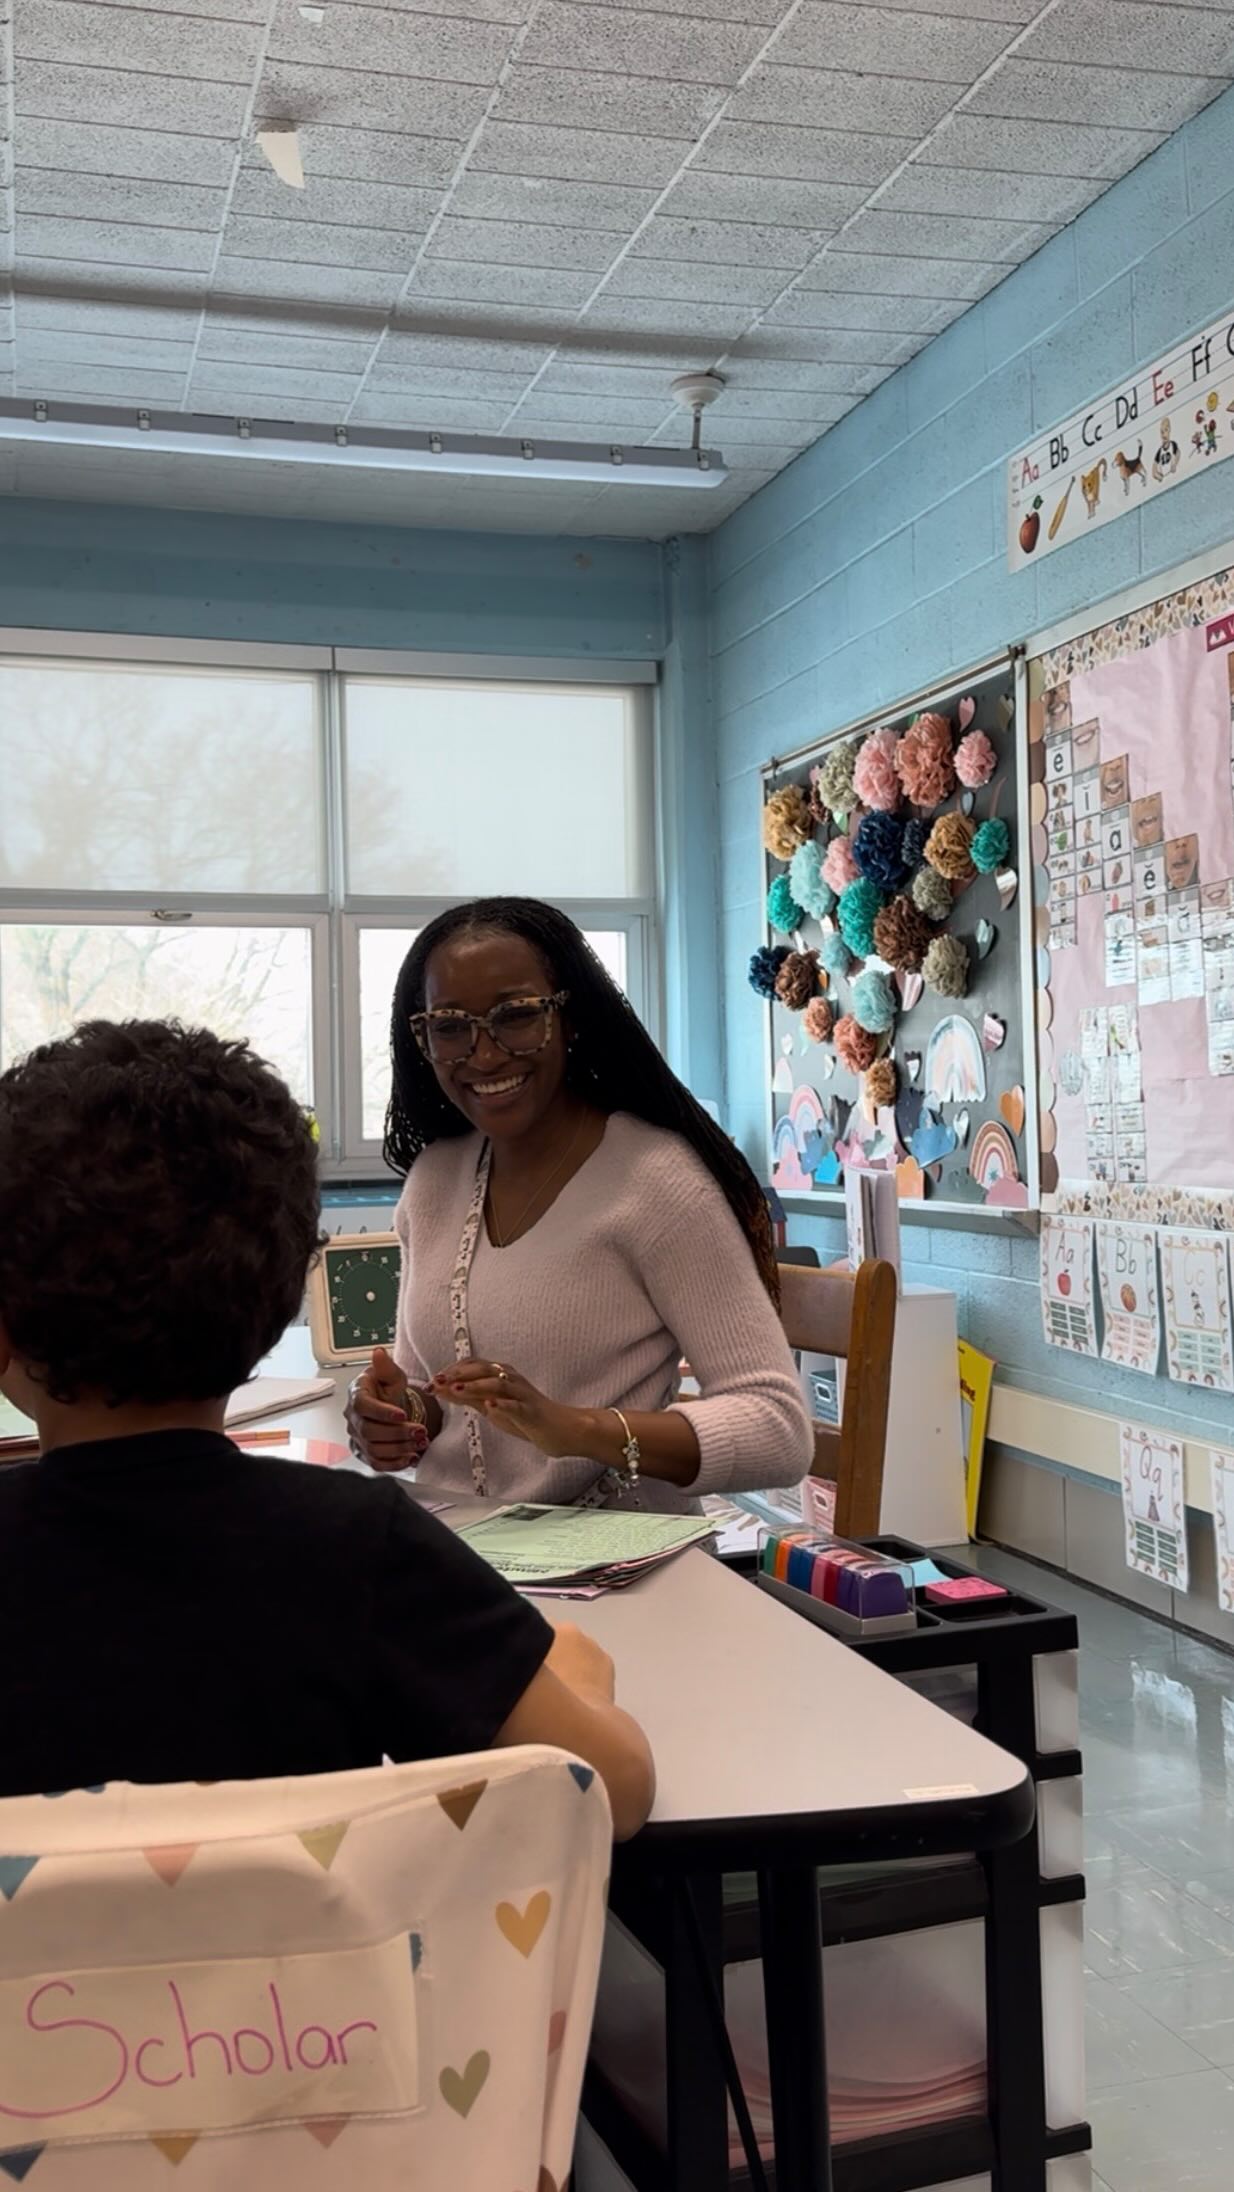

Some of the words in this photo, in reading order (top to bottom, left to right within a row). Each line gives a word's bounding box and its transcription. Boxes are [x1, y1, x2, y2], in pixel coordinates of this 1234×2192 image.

[1021, 457, 1039, 488] Aa
[1050, 434, 1069, 469] Bb
[1082, 415, 1102, 446] Cc
[1115, 387, 1138, 429] Dd
[1152, 370, 1174, 406] Ee
[1191, 338, 1212, 382] Ff
[1055, 1232, 1074, 1263] Aa
[1115, 1238, 1137, 1274] Bb
[1139, 1445, 1163, 1501] Qq
[0, 1980, 377, 2119] Scholar
